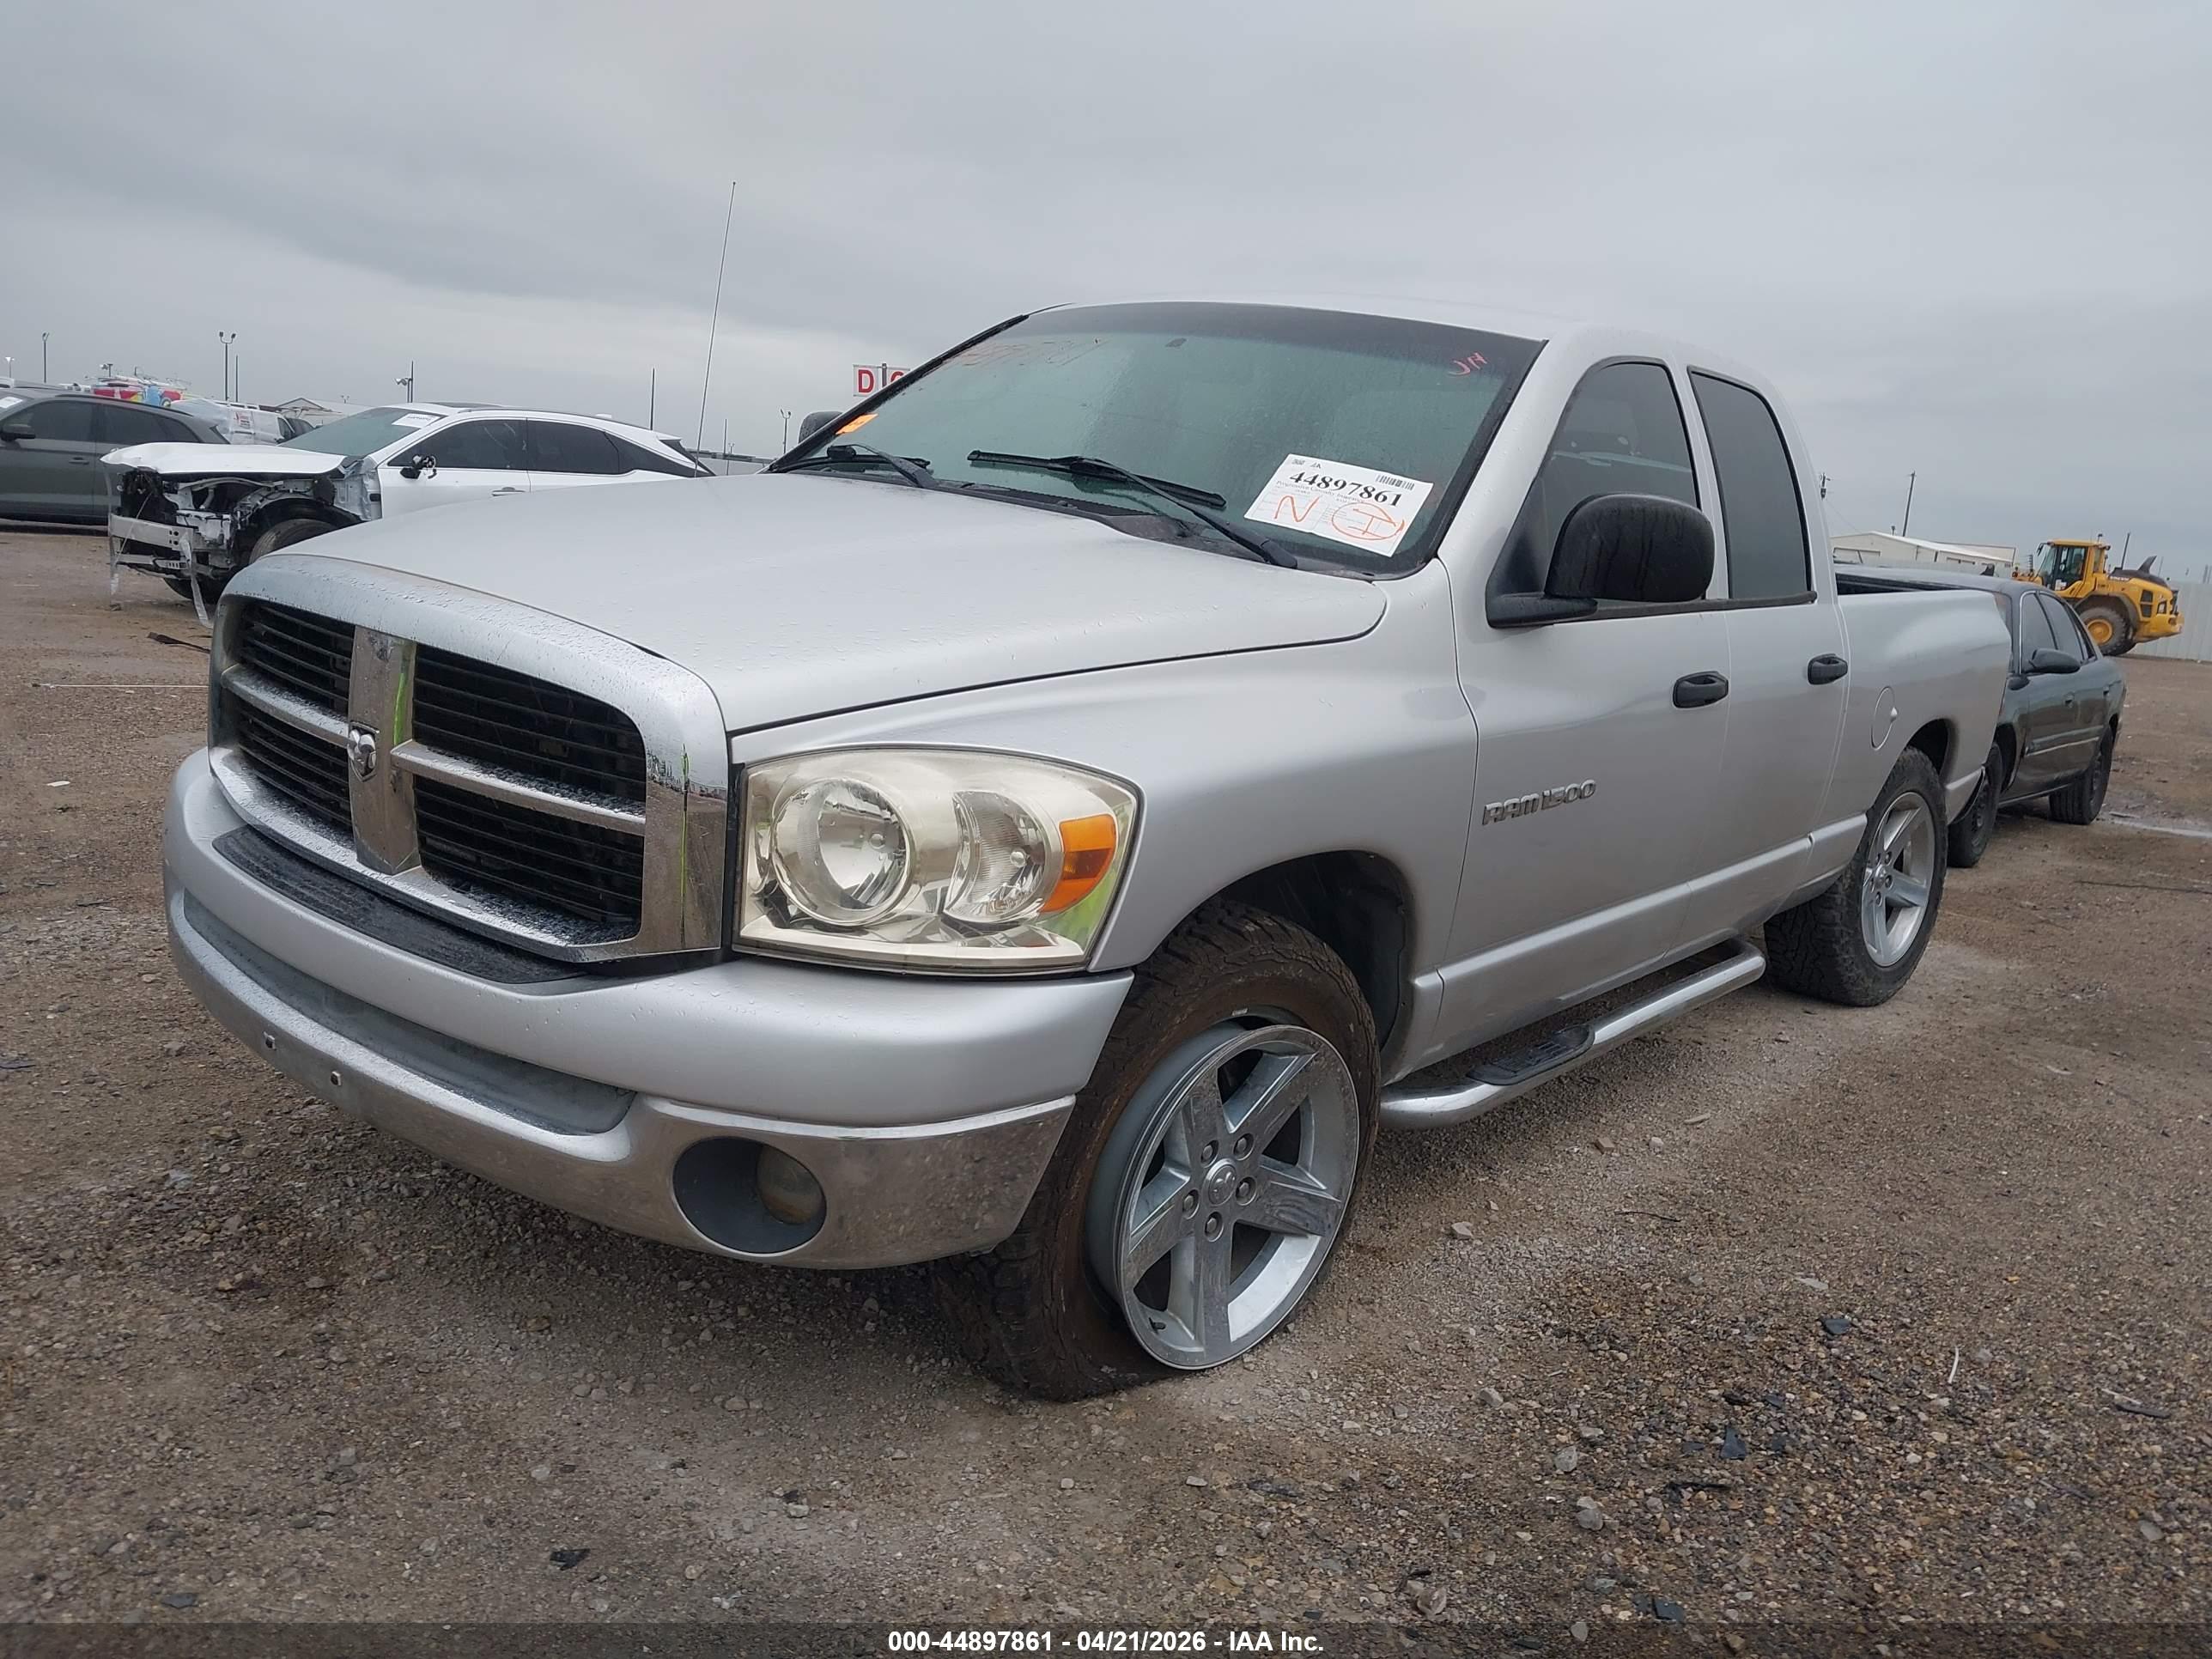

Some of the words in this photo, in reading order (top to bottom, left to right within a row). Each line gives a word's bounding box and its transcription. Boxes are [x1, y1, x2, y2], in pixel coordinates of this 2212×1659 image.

[1290, 471, 1401, 506] 44897861
[1482, 793, 1539, 825] RAM
[1541, 779, 1596, 809] 1500
